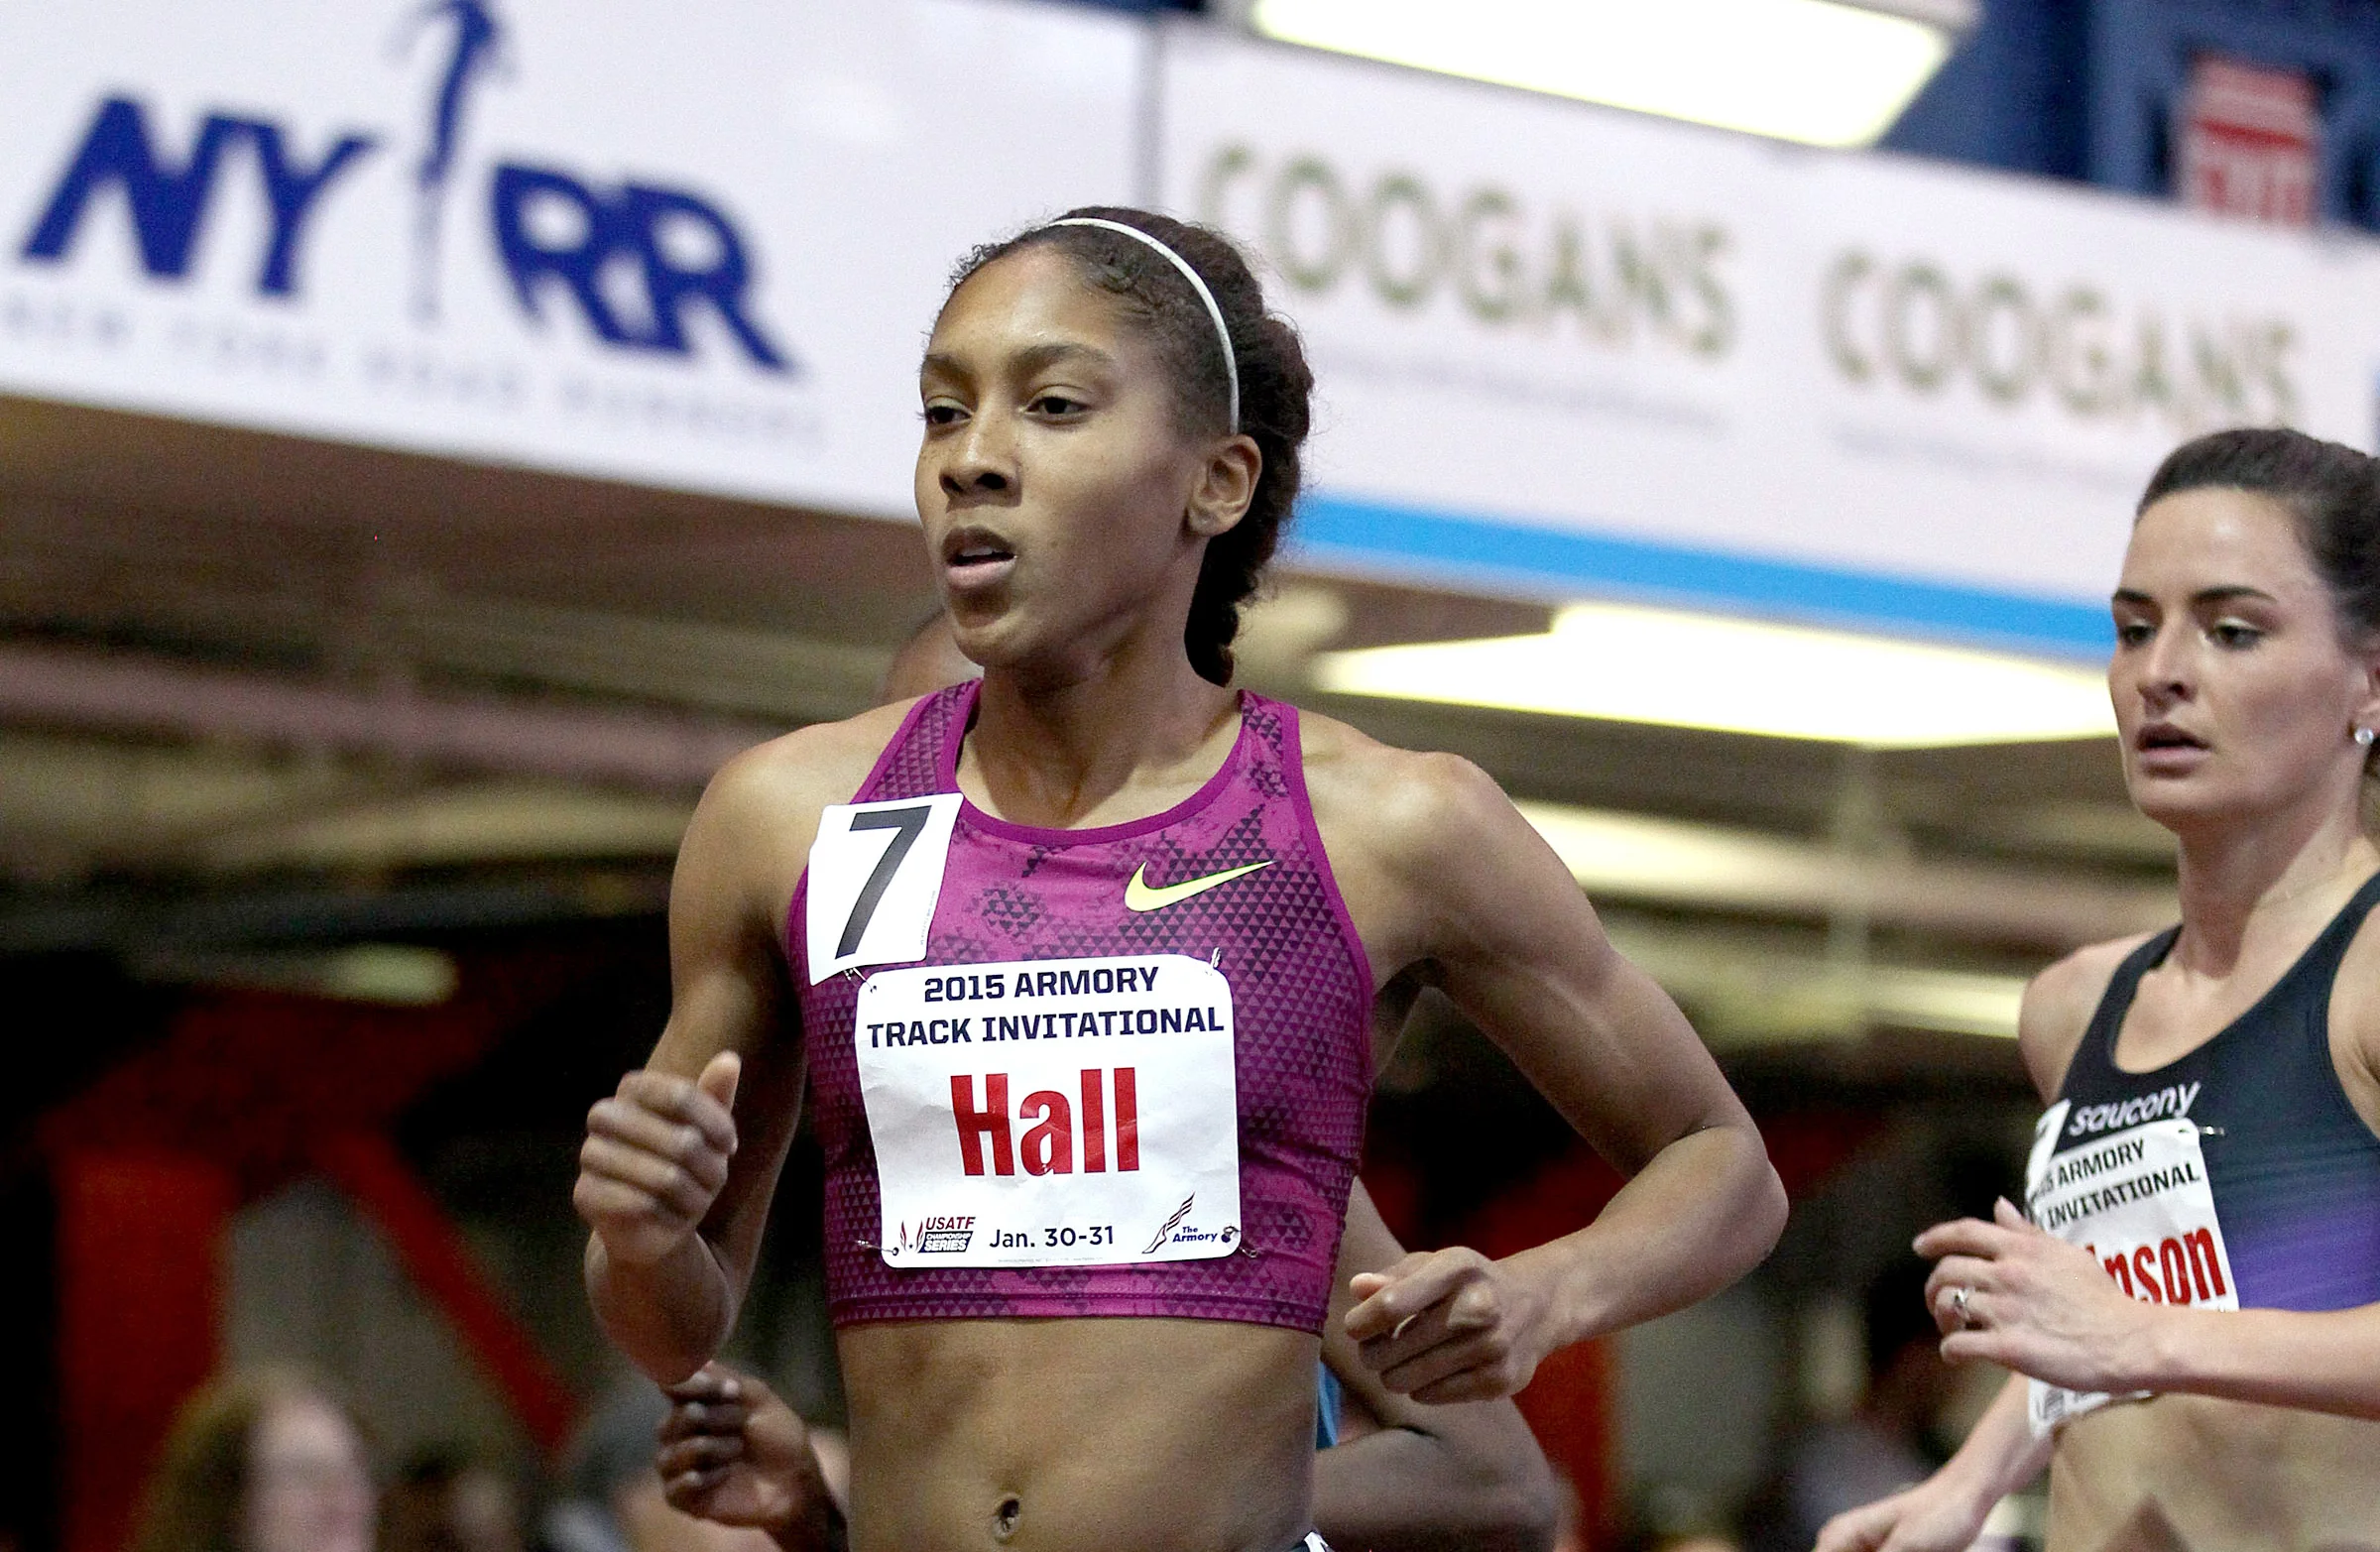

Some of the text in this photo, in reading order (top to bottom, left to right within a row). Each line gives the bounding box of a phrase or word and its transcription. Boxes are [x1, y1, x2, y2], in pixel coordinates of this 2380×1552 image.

[1197, 137, 1739, 359] COOGANS
[1820, 246, 2301, 428] COOGANS
[835, 804, 932, 960] 7
[924, 966, 1159, 1004] 2015 ARMORY
[867, 1007, 1225, 1048] TRACK INVITATIONAL
[950, 1066, 1140, 1177] Hall
[2069, 1081, 2202, 1136] saucony
[2058, 1138, 2145, 1187] ARMORY
[2048, 1161, 2200, 1229] INVITATIONAL
[923, 1239, 968, 1252] SERIES
[925, 1216, 977, 1231] USATF
[989, 1225, 1114, 1248] Jan. 30-31
[1172, 1232, 1219, 1244] Armory
